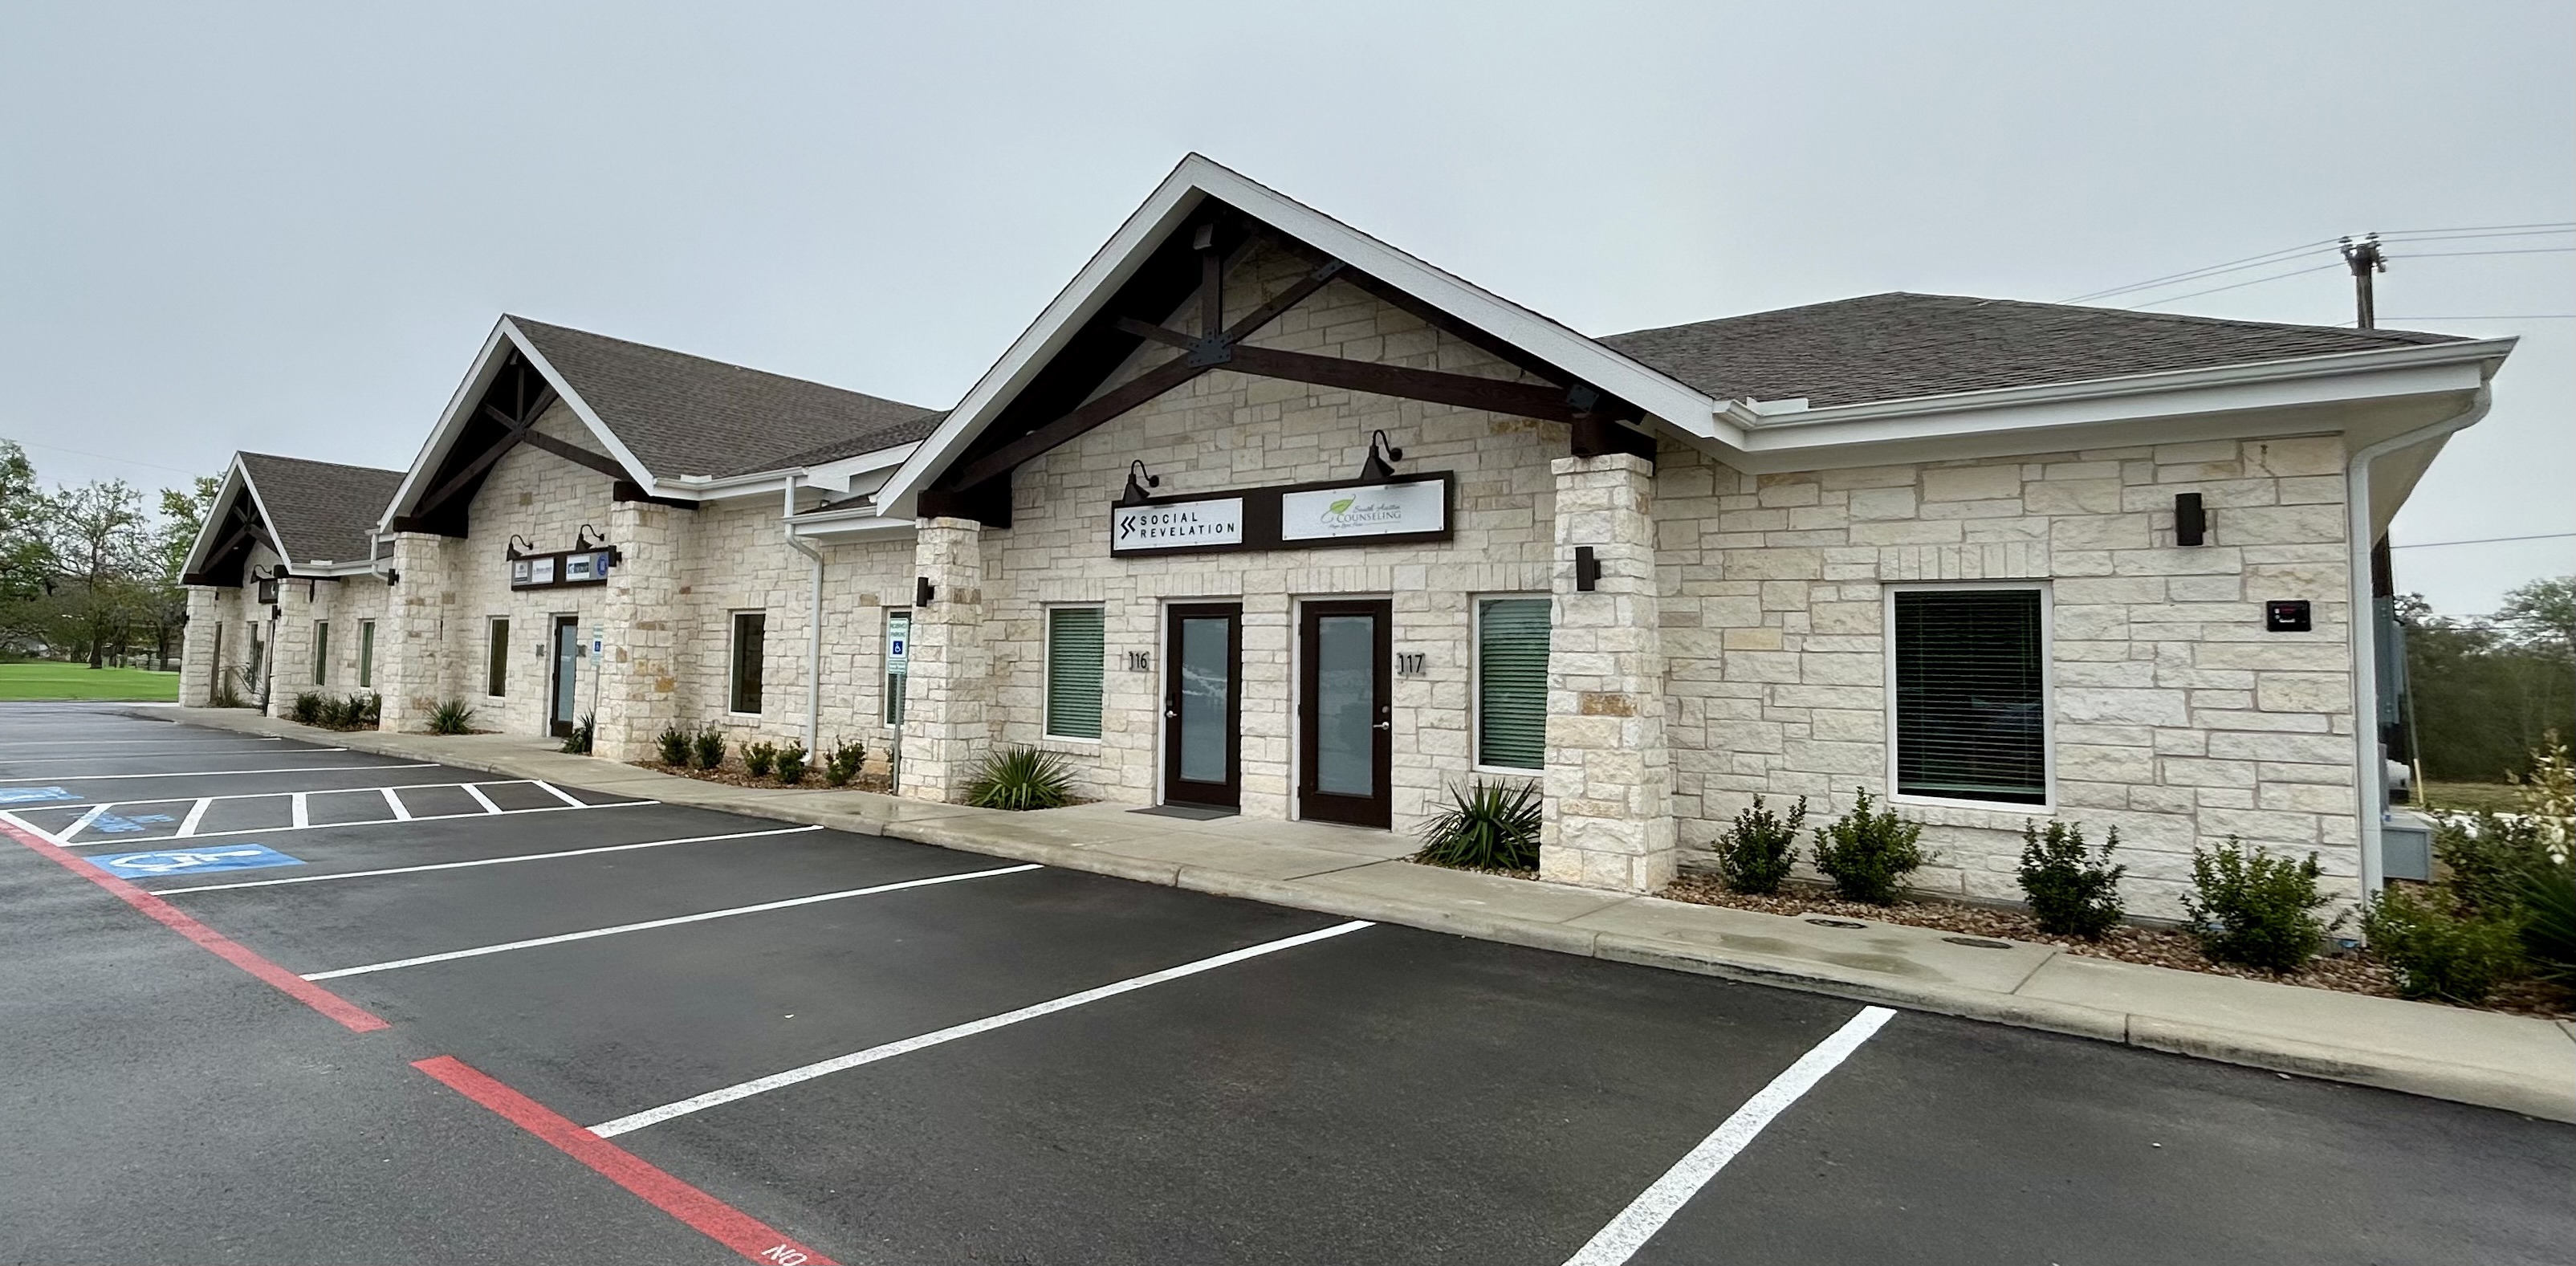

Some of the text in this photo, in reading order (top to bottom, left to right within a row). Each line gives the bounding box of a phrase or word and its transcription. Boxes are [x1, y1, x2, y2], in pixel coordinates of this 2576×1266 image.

[1140, 511, 1198, 526] SOCIAL
[1336, 511, 1402, 523] COUNSELING
[1140, 523, 1235, 539] REVELATION
[1128, 651, 1148, 669] 116
[1398, 654, 1423, 674] 117
[761, 1244, 808, 1266] NO
